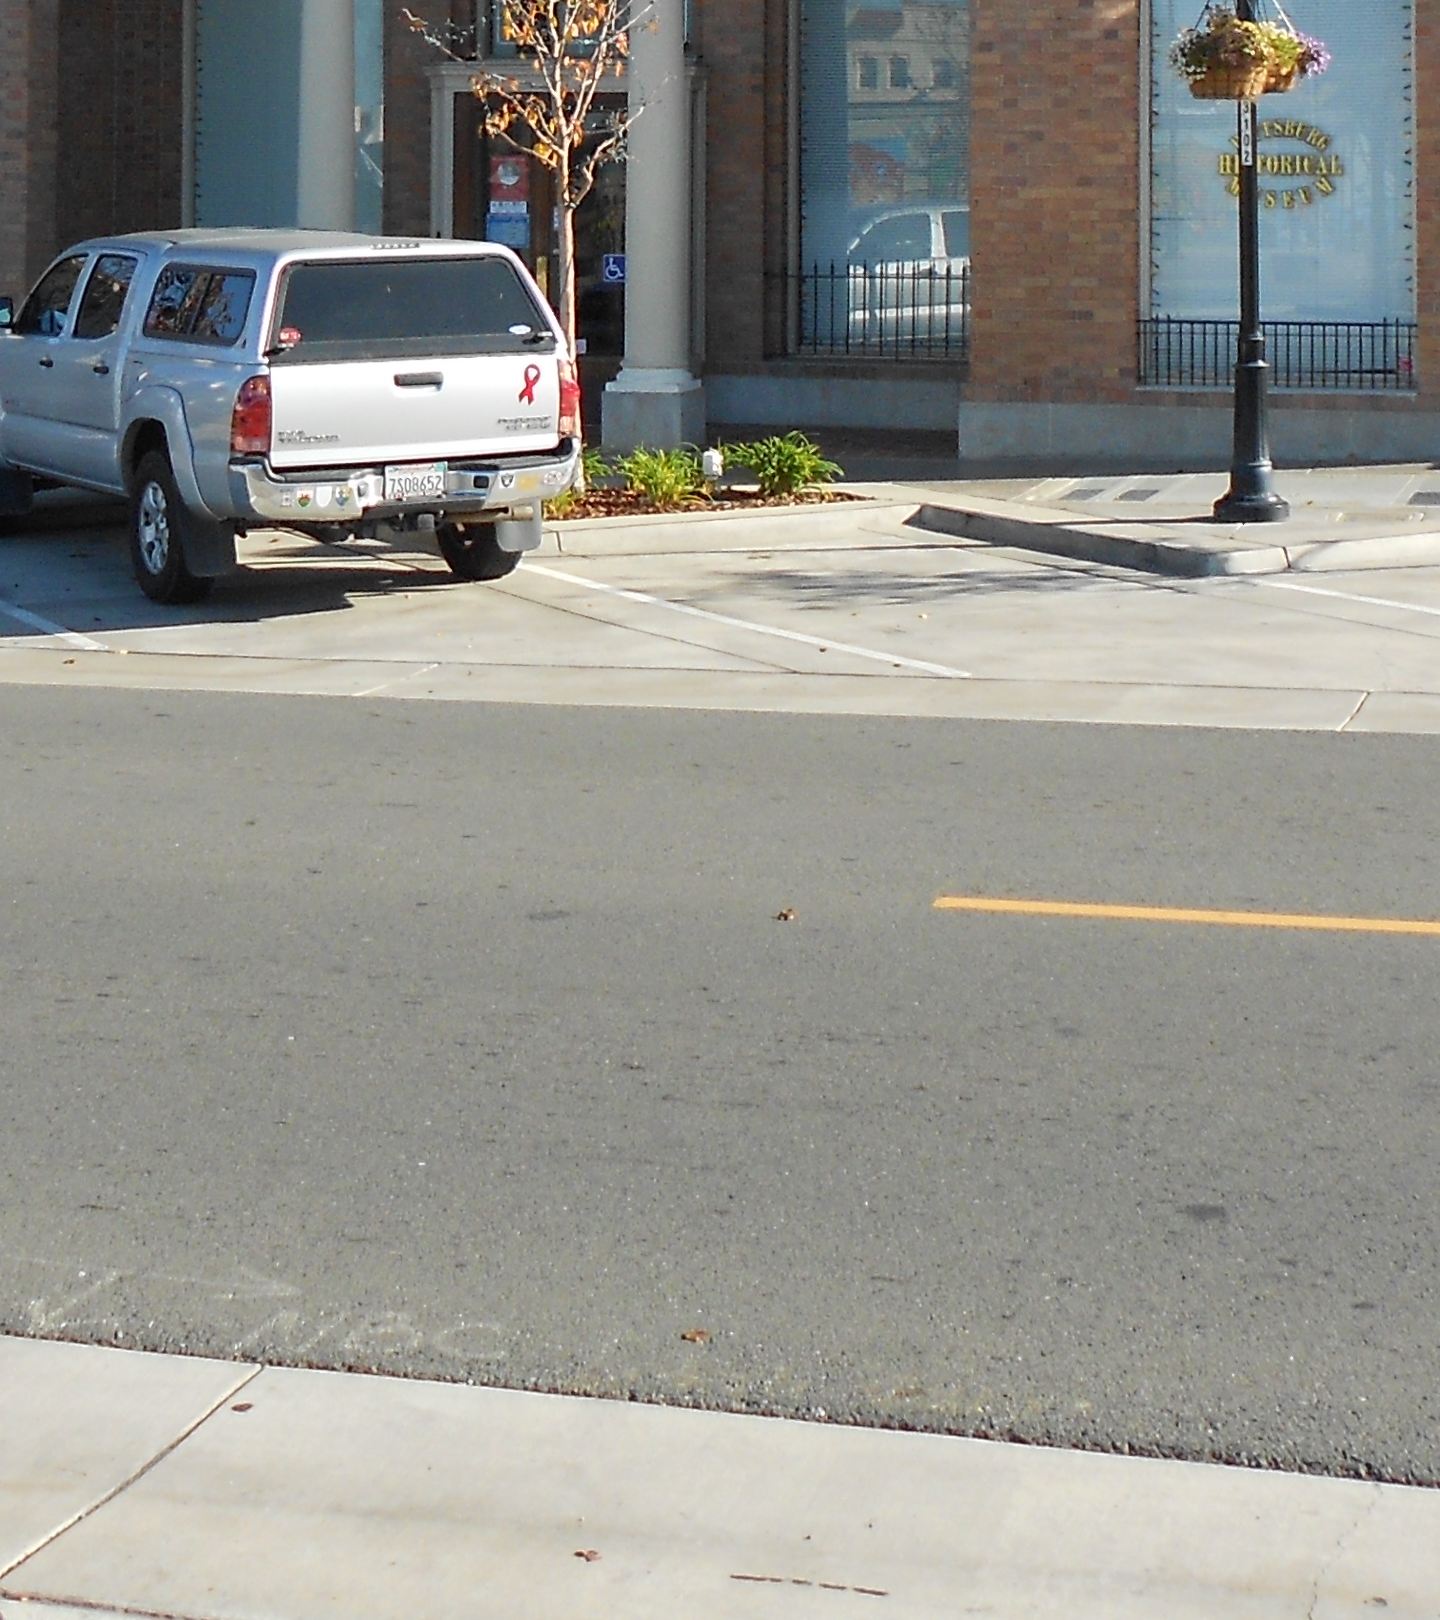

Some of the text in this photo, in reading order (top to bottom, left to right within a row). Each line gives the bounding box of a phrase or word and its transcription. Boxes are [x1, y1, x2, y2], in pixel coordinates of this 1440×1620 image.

[1219, 154, 1344, 176] HITORICAL
[1226, 176, 1336, 208] MSEUM
[390, 474, 442, 493] 7S08652
